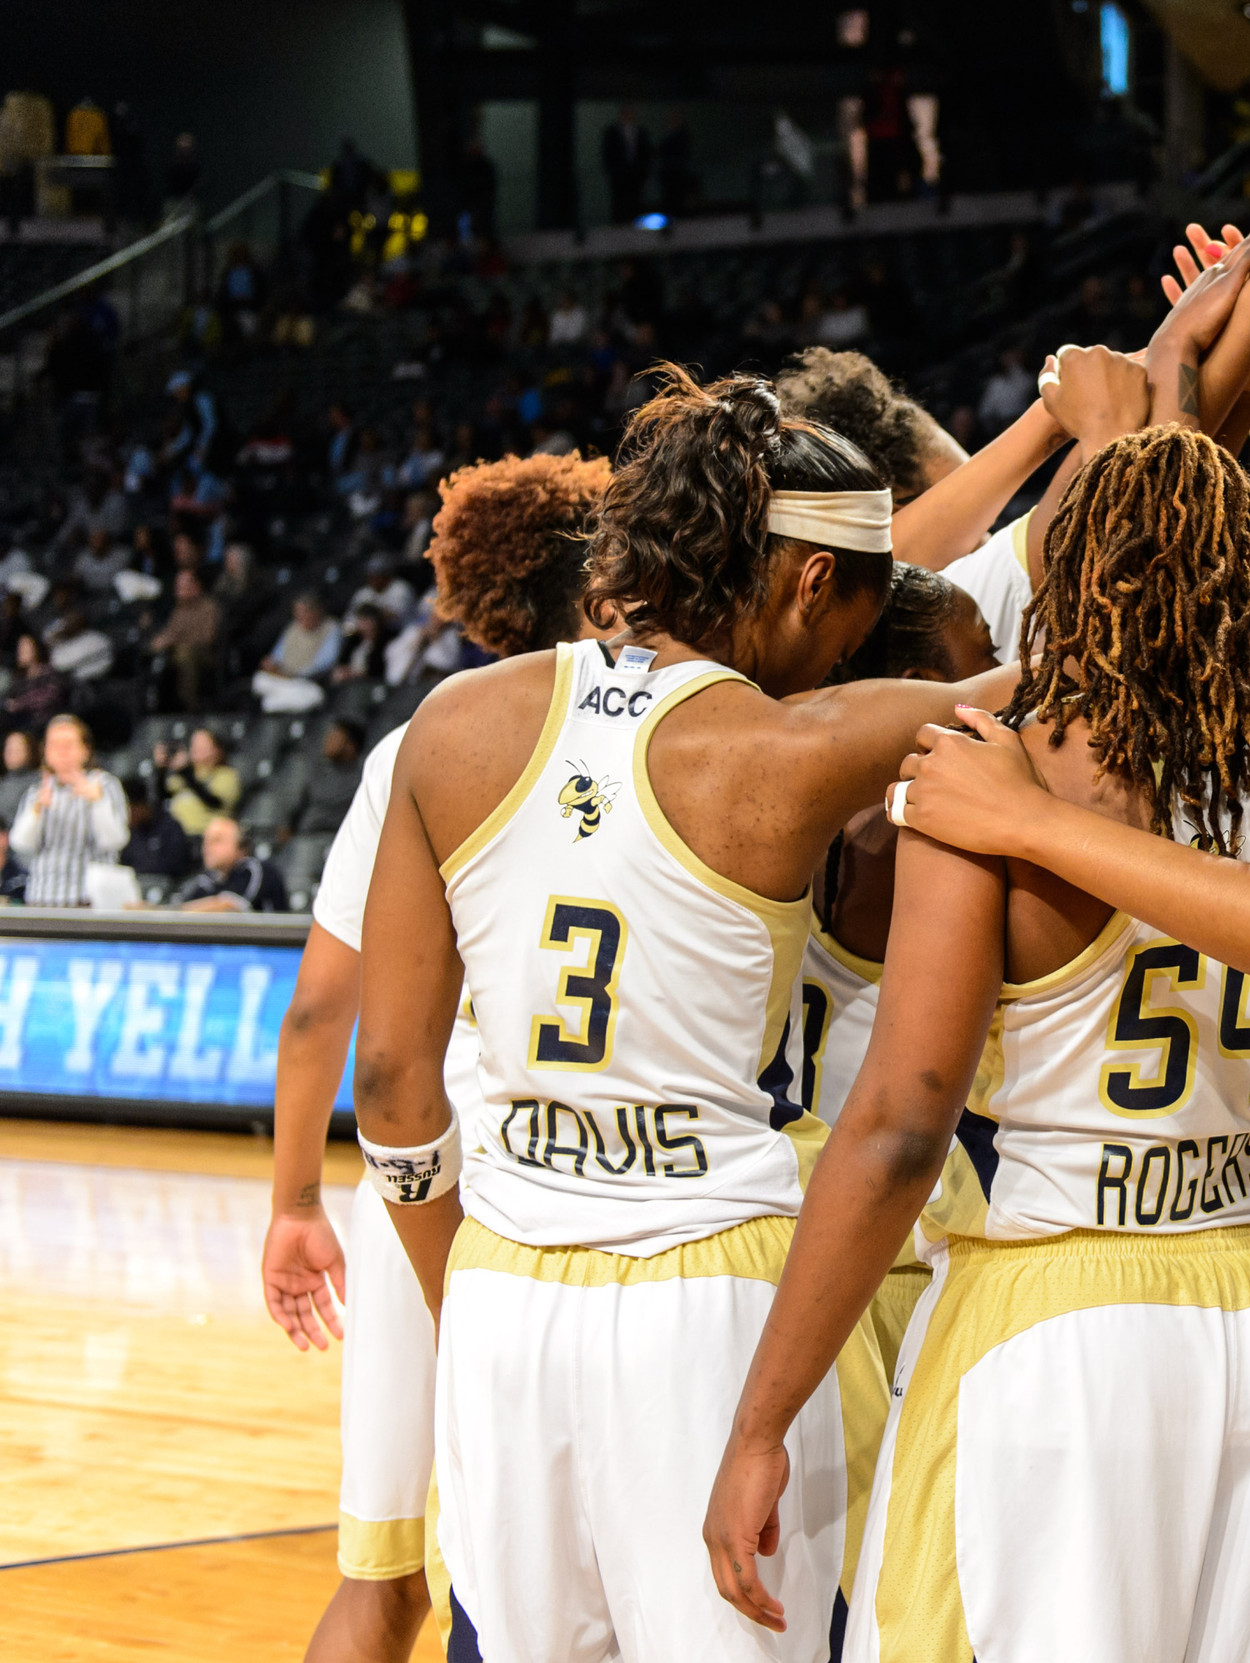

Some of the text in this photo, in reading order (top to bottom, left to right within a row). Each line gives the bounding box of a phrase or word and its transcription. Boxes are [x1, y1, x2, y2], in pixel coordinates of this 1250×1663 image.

[577, 685, 653, 718] ACC
[526, 894, 628, 1072] 3
[498, 1097, 708, 1180] DAVIS
[385, 1164, 441, 1184] RUSSELL
